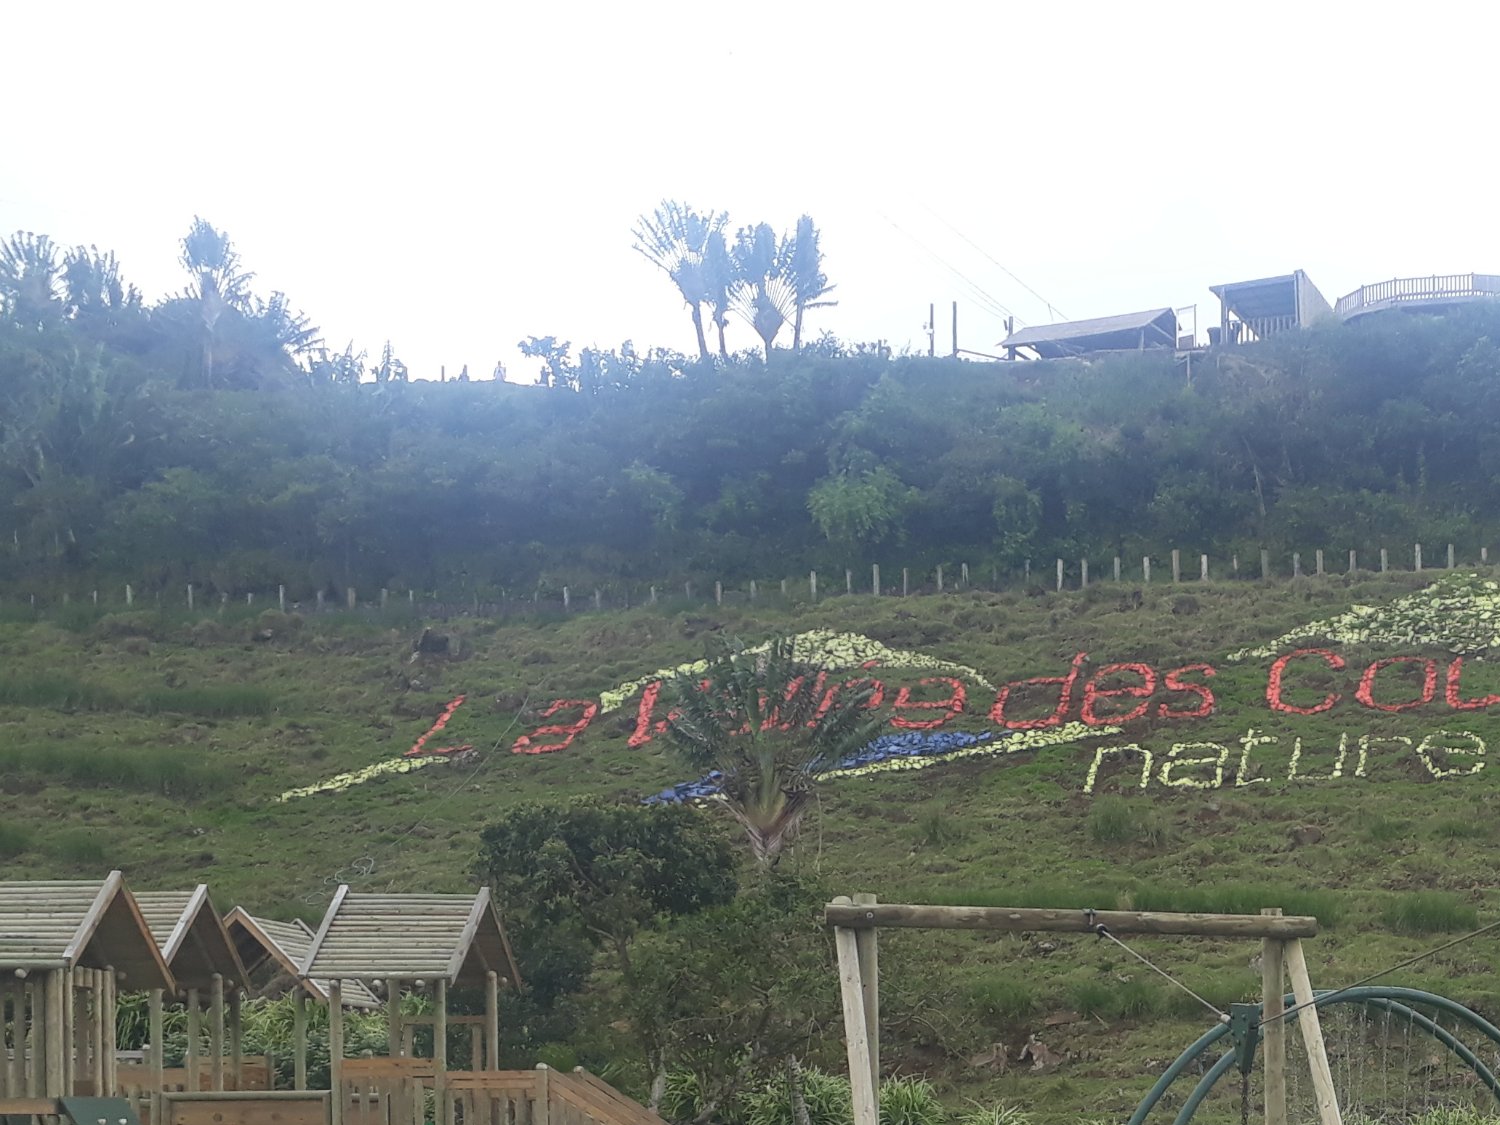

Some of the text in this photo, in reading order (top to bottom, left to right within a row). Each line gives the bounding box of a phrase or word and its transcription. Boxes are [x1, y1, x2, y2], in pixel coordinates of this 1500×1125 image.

[403, 694, 598, 755] La
[988, 651, 1217, 730] des
[1083, 727, 1487, 793] nature
